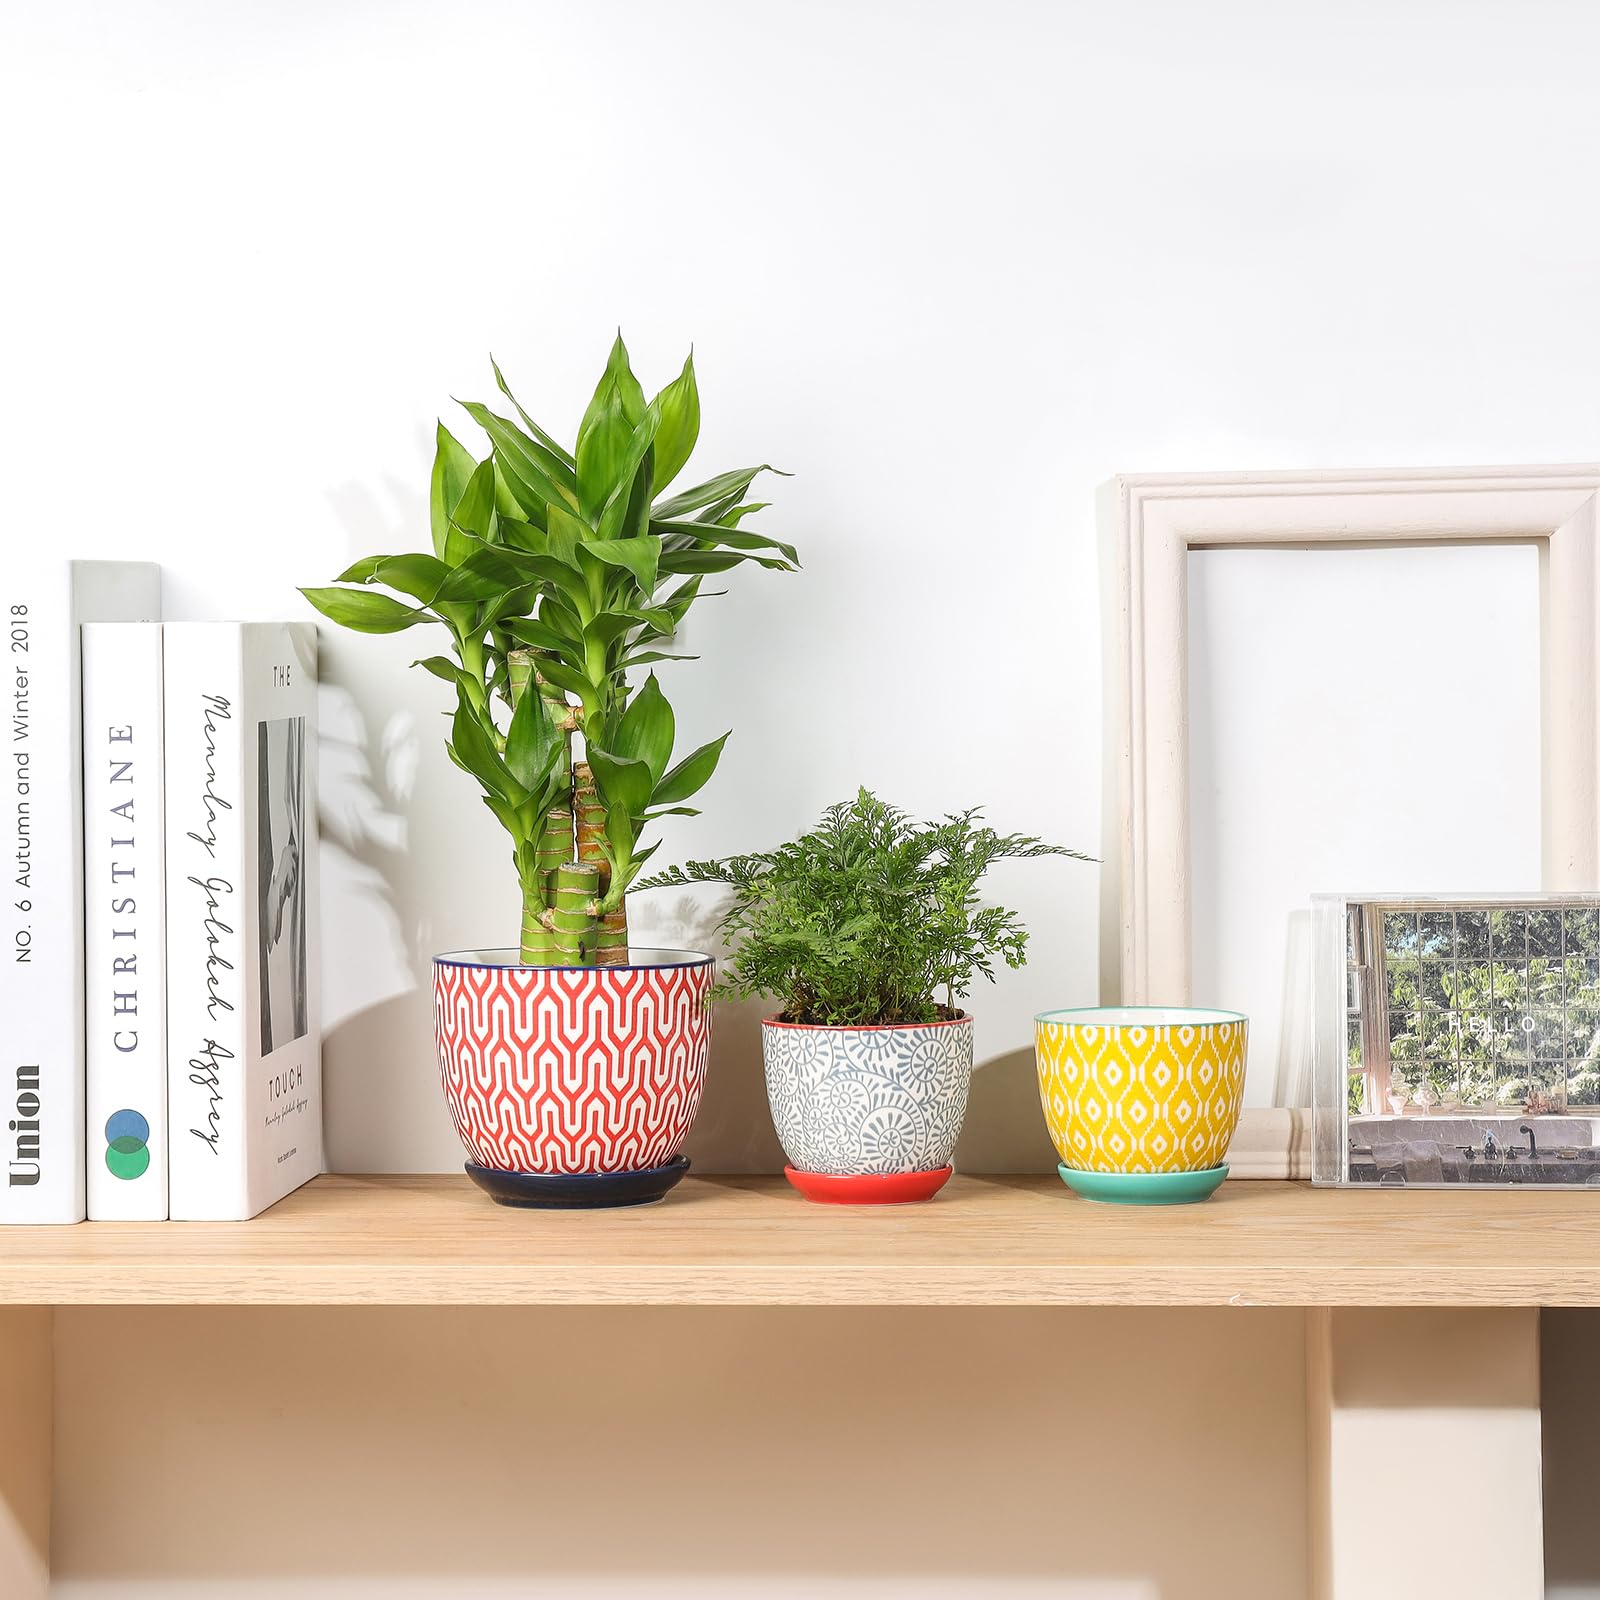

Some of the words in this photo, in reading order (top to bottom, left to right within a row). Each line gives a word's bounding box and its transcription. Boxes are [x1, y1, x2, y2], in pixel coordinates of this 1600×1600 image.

[10, 604, 29, 653] 2018
[273, 665, 291, 688] THE
[12, 665, 29, 742] Winter
[12, 752, 30, 796] and
[15, 802, 31, 889] Autumn
[14, 899, 32, 912] 6
[108, 724, 139, 1053] CHRISTIANE
[15, 924, 32, 963] NO.
[1448, 1016, 1536, 1033] HELLO
[268, 1063, 303, 1102] TOUCH
[8, 1064, 41, 1188] Union
